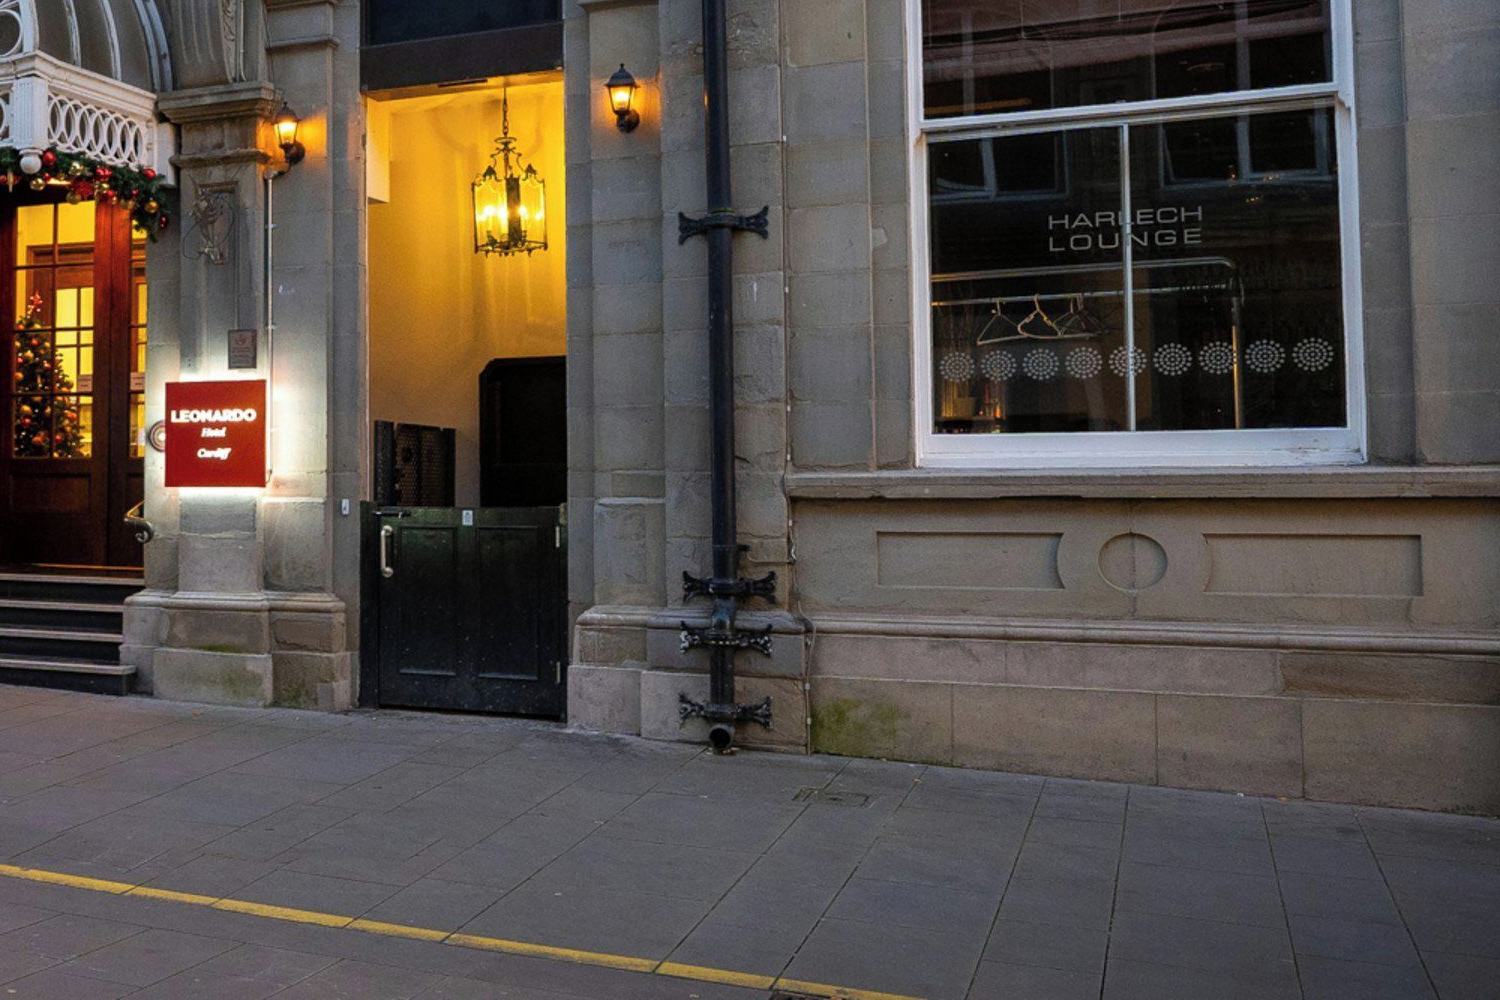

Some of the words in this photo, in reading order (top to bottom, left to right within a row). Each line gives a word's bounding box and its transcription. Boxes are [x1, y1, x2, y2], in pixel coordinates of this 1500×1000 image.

[1048, 205, 1202, 230] HARLECH
[1049, 228, 1202, 251] LOUNGE
[170, 408, 258, 424] LEONARDO
